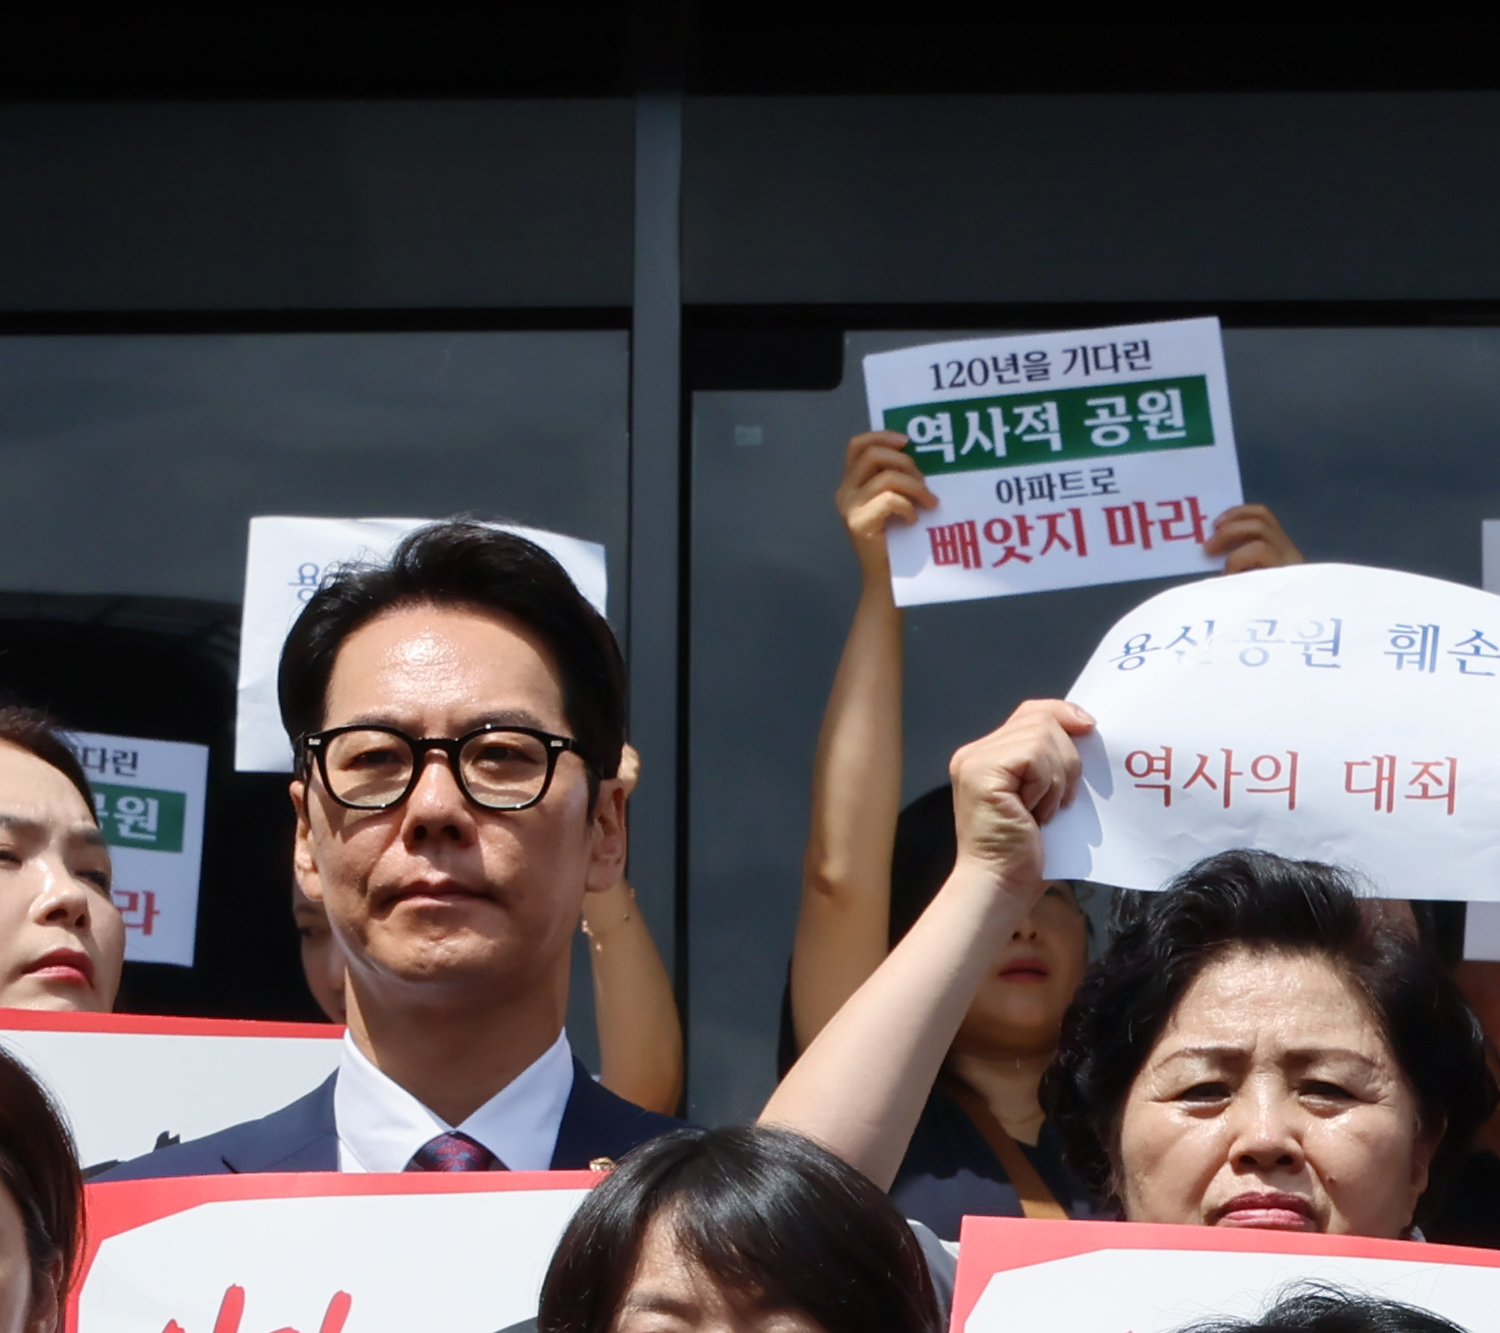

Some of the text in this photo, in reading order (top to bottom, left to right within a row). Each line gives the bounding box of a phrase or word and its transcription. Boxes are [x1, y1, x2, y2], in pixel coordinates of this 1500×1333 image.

[929, 339, 1153, 391] 120년을 기다린
[906, 388, 1187, 463] 역사적 공원
[995, 466, 1120, 506] 아파트로
[926, 496, 1209, 570] 빼앗지 마라
[1108, 618, 1343, 671] 용산공원
[76, 746, 138, 777] 다린
[1123, 745, 1458, 815] 역사의 대죄
